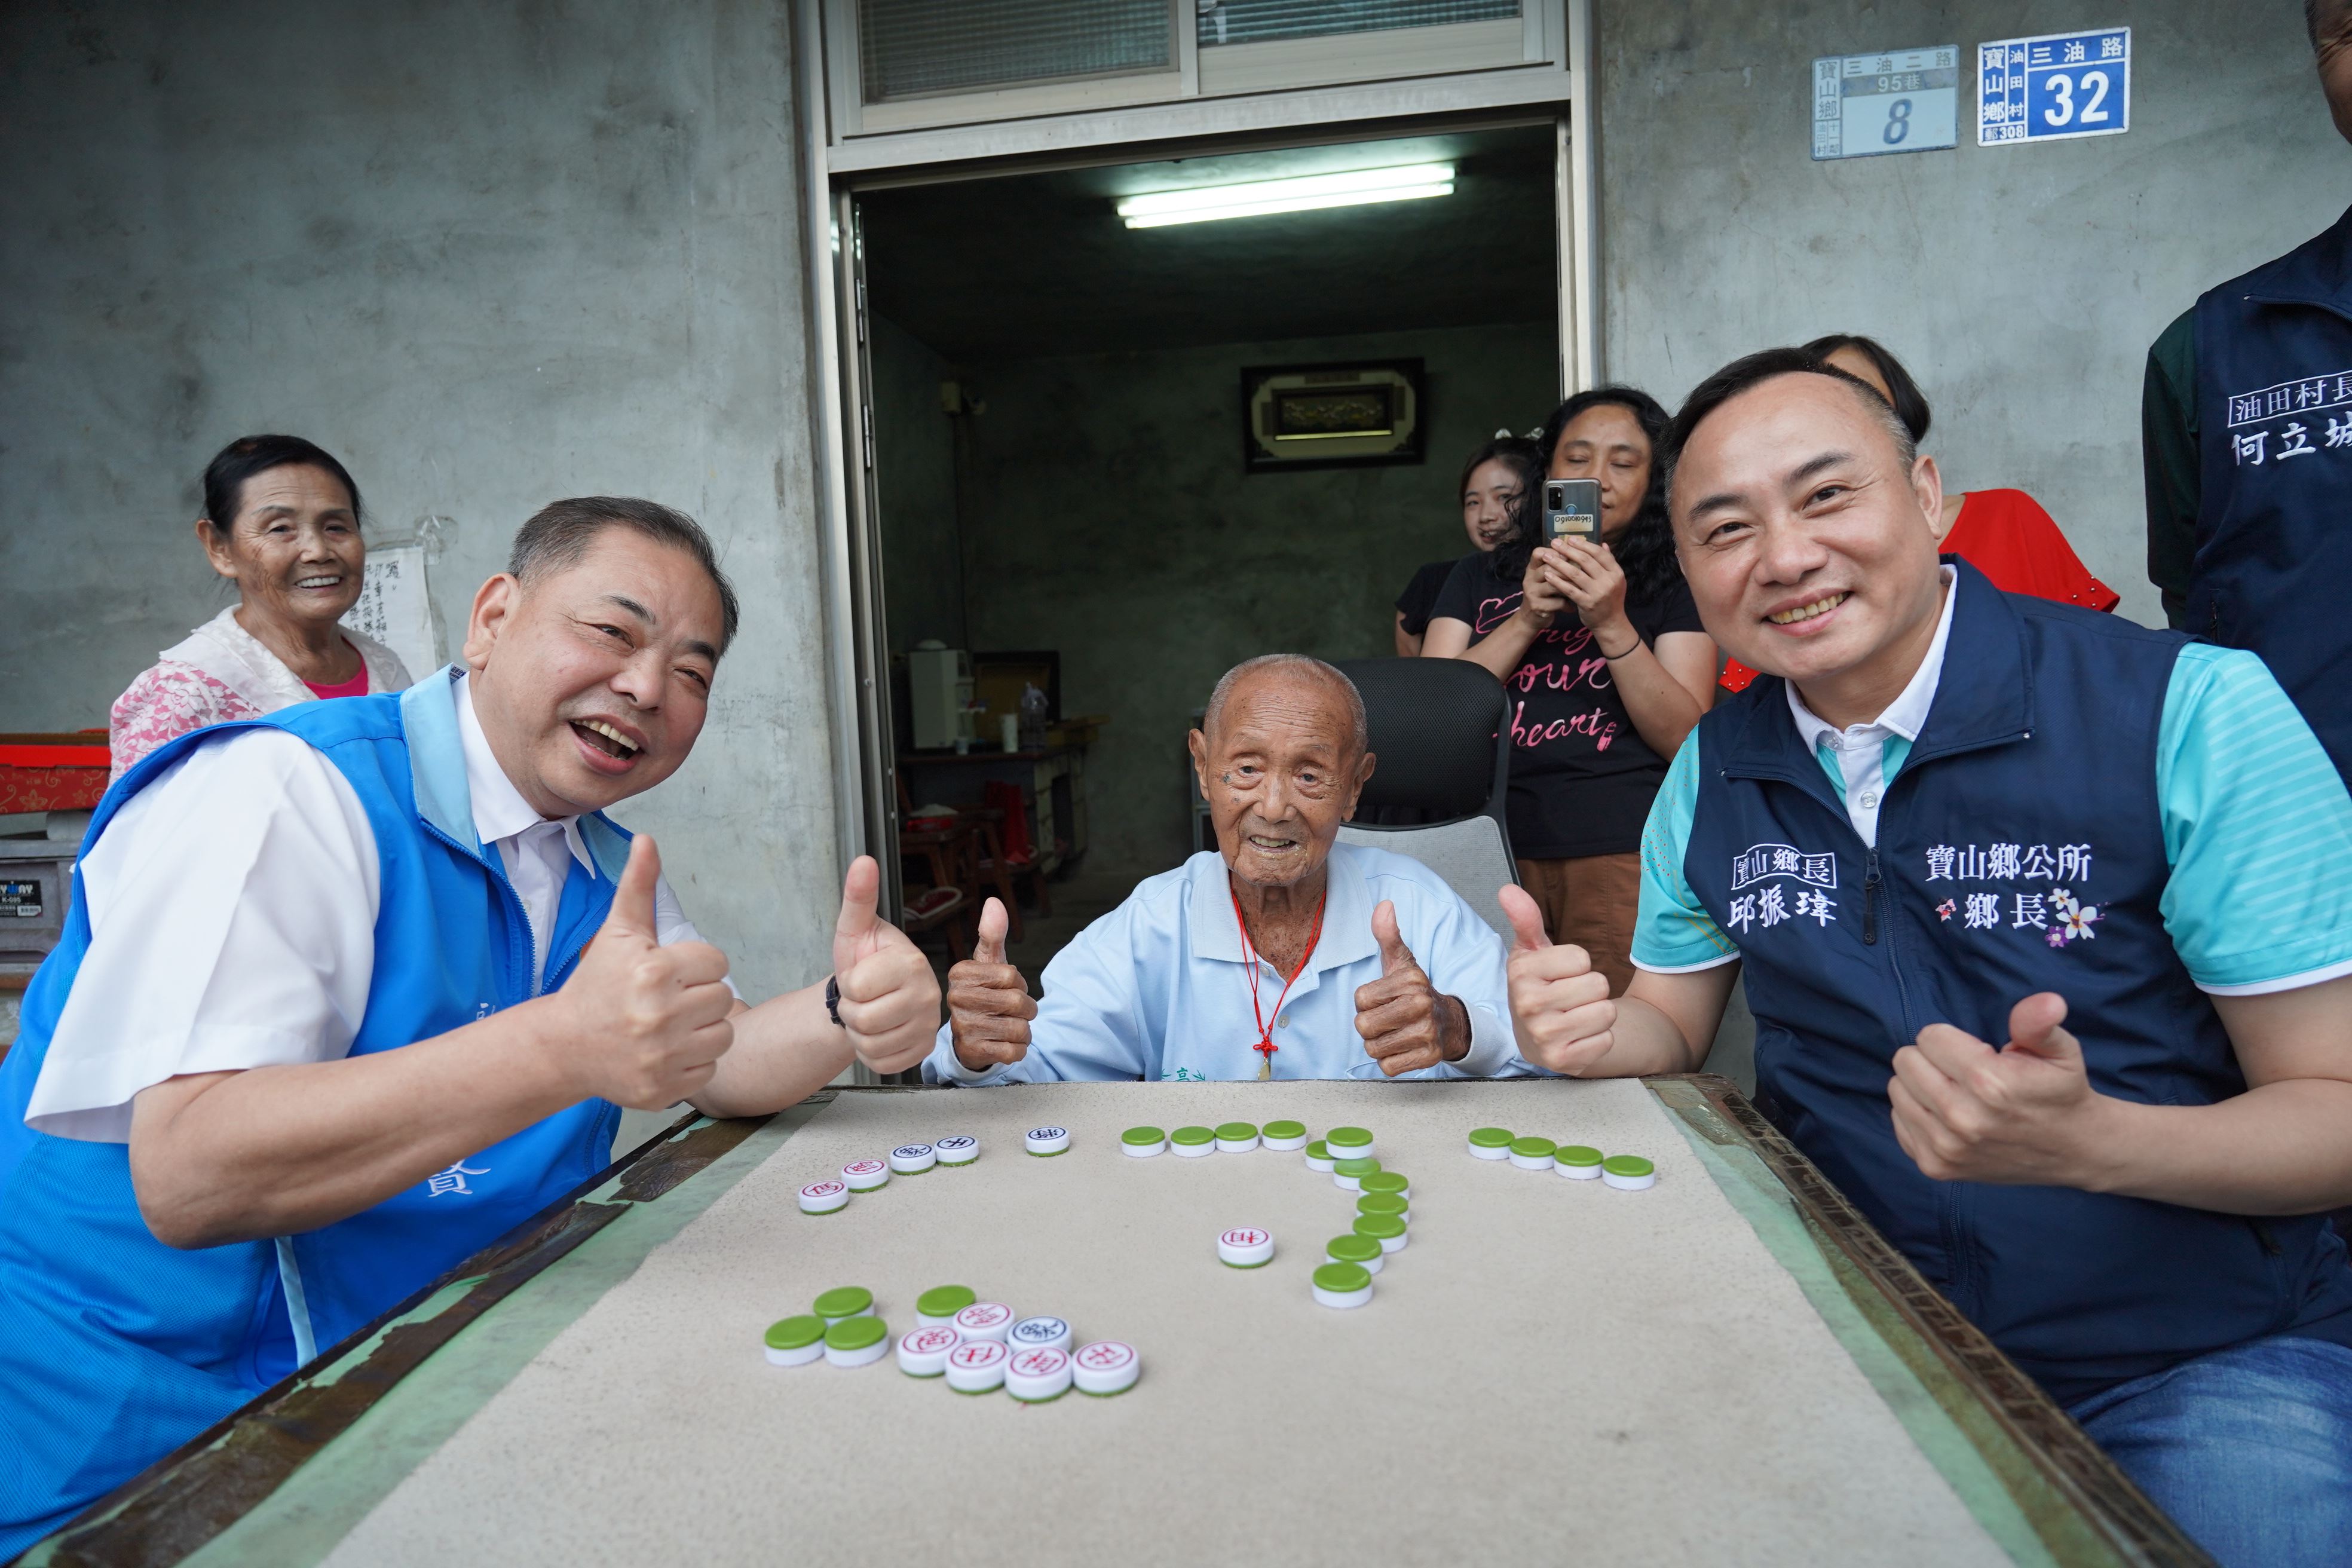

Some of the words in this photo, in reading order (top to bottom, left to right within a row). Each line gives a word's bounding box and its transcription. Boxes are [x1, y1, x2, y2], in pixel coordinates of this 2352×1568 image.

[1847, 51, 1952, 75] 三油二路
[2031, 36, 2123, 65] 三油路
[1818, 62, 1838, 118] 寶山鄉
[1876, 72, 1921, 92] 95巷
[1983, 48, 2005, 122] 寶山鄉
[2009, 50, 2025, 118] 油田村
[2044, 71, 2109, 127] 32
[1883, 98, 1912, 145] 8
[1504, 657, 1612, 693] our
[1511, 700, 1609, 747] heart
[1737, 848, 1830, 885] 寶山鄉長
[1925, 843, 2092, 882] 寶山鄉公所
[1727, 883, 1838, 935] 邱振瑋
[1964, 892, 2048, 930] 鄉長
